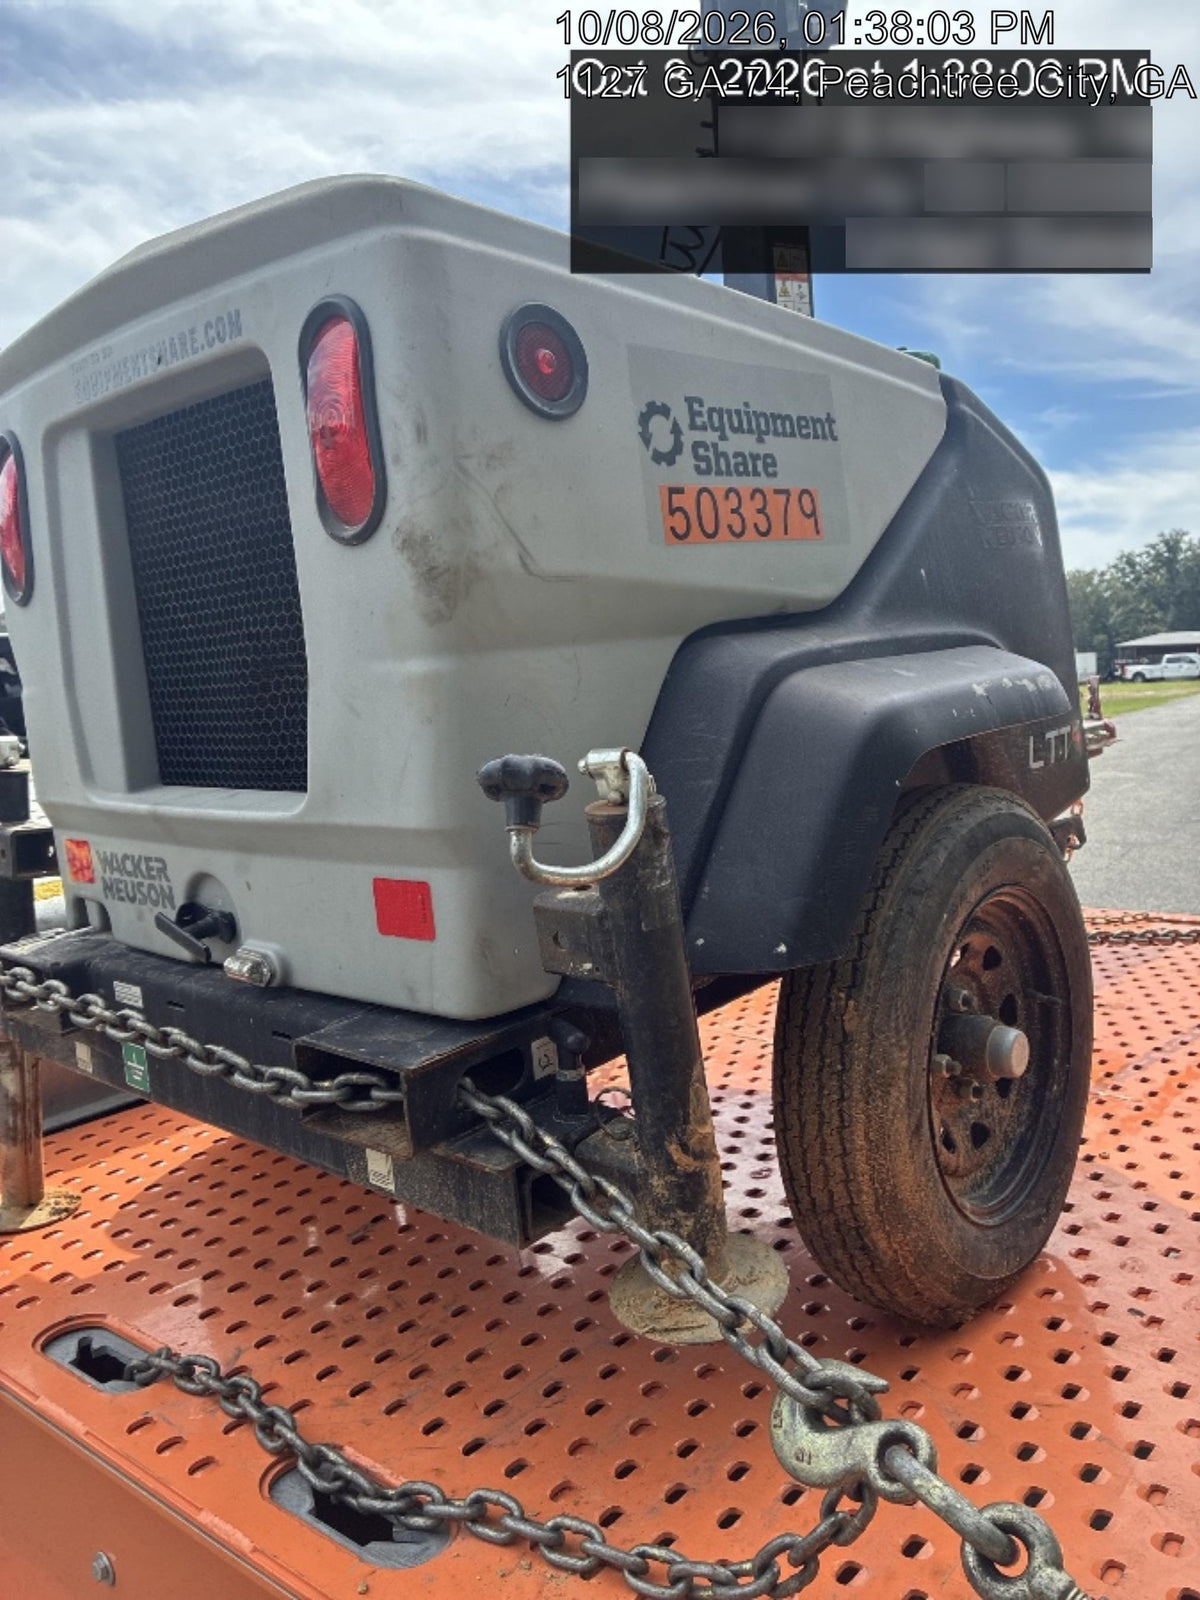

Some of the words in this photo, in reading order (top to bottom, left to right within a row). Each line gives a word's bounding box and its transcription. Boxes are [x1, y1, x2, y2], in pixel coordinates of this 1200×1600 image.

[684, 396, 838, 443] Equipment
[692, 440, 778, 478] Share
[667, 486, 820, 541] 503379
[95, 850, 171, 883] WACKER
[101, 876, 176, 911] NEUSON
